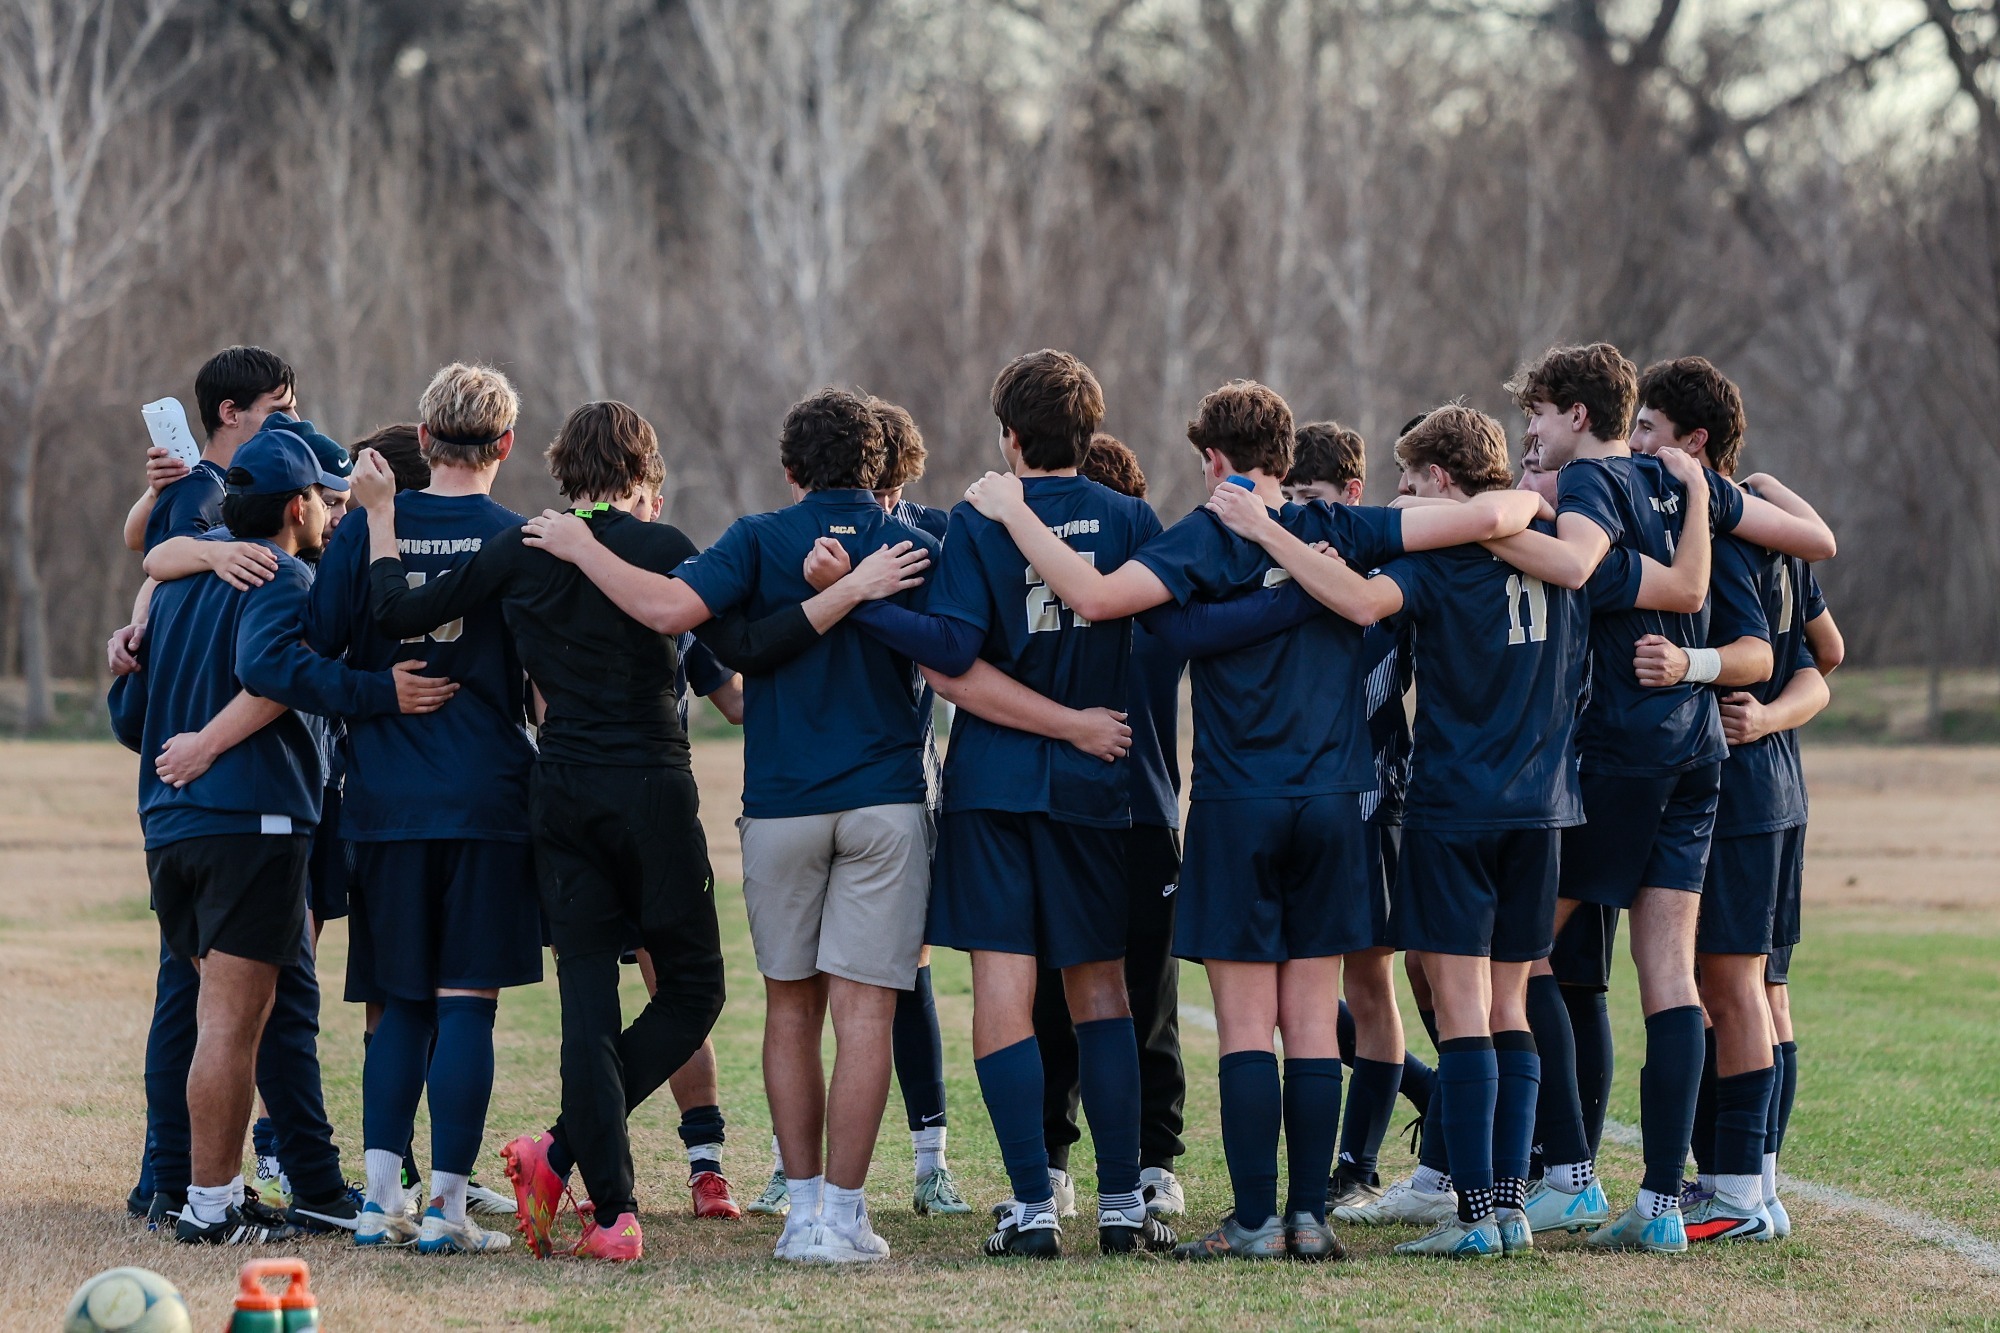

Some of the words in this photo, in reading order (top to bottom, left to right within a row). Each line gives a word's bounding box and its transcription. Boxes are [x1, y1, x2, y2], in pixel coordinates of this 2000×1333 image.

[829, 525, 857, 534] MCA
[396, 538, 482, 554] MUSTANGS
[1506, 573, 1547, 645] 11
